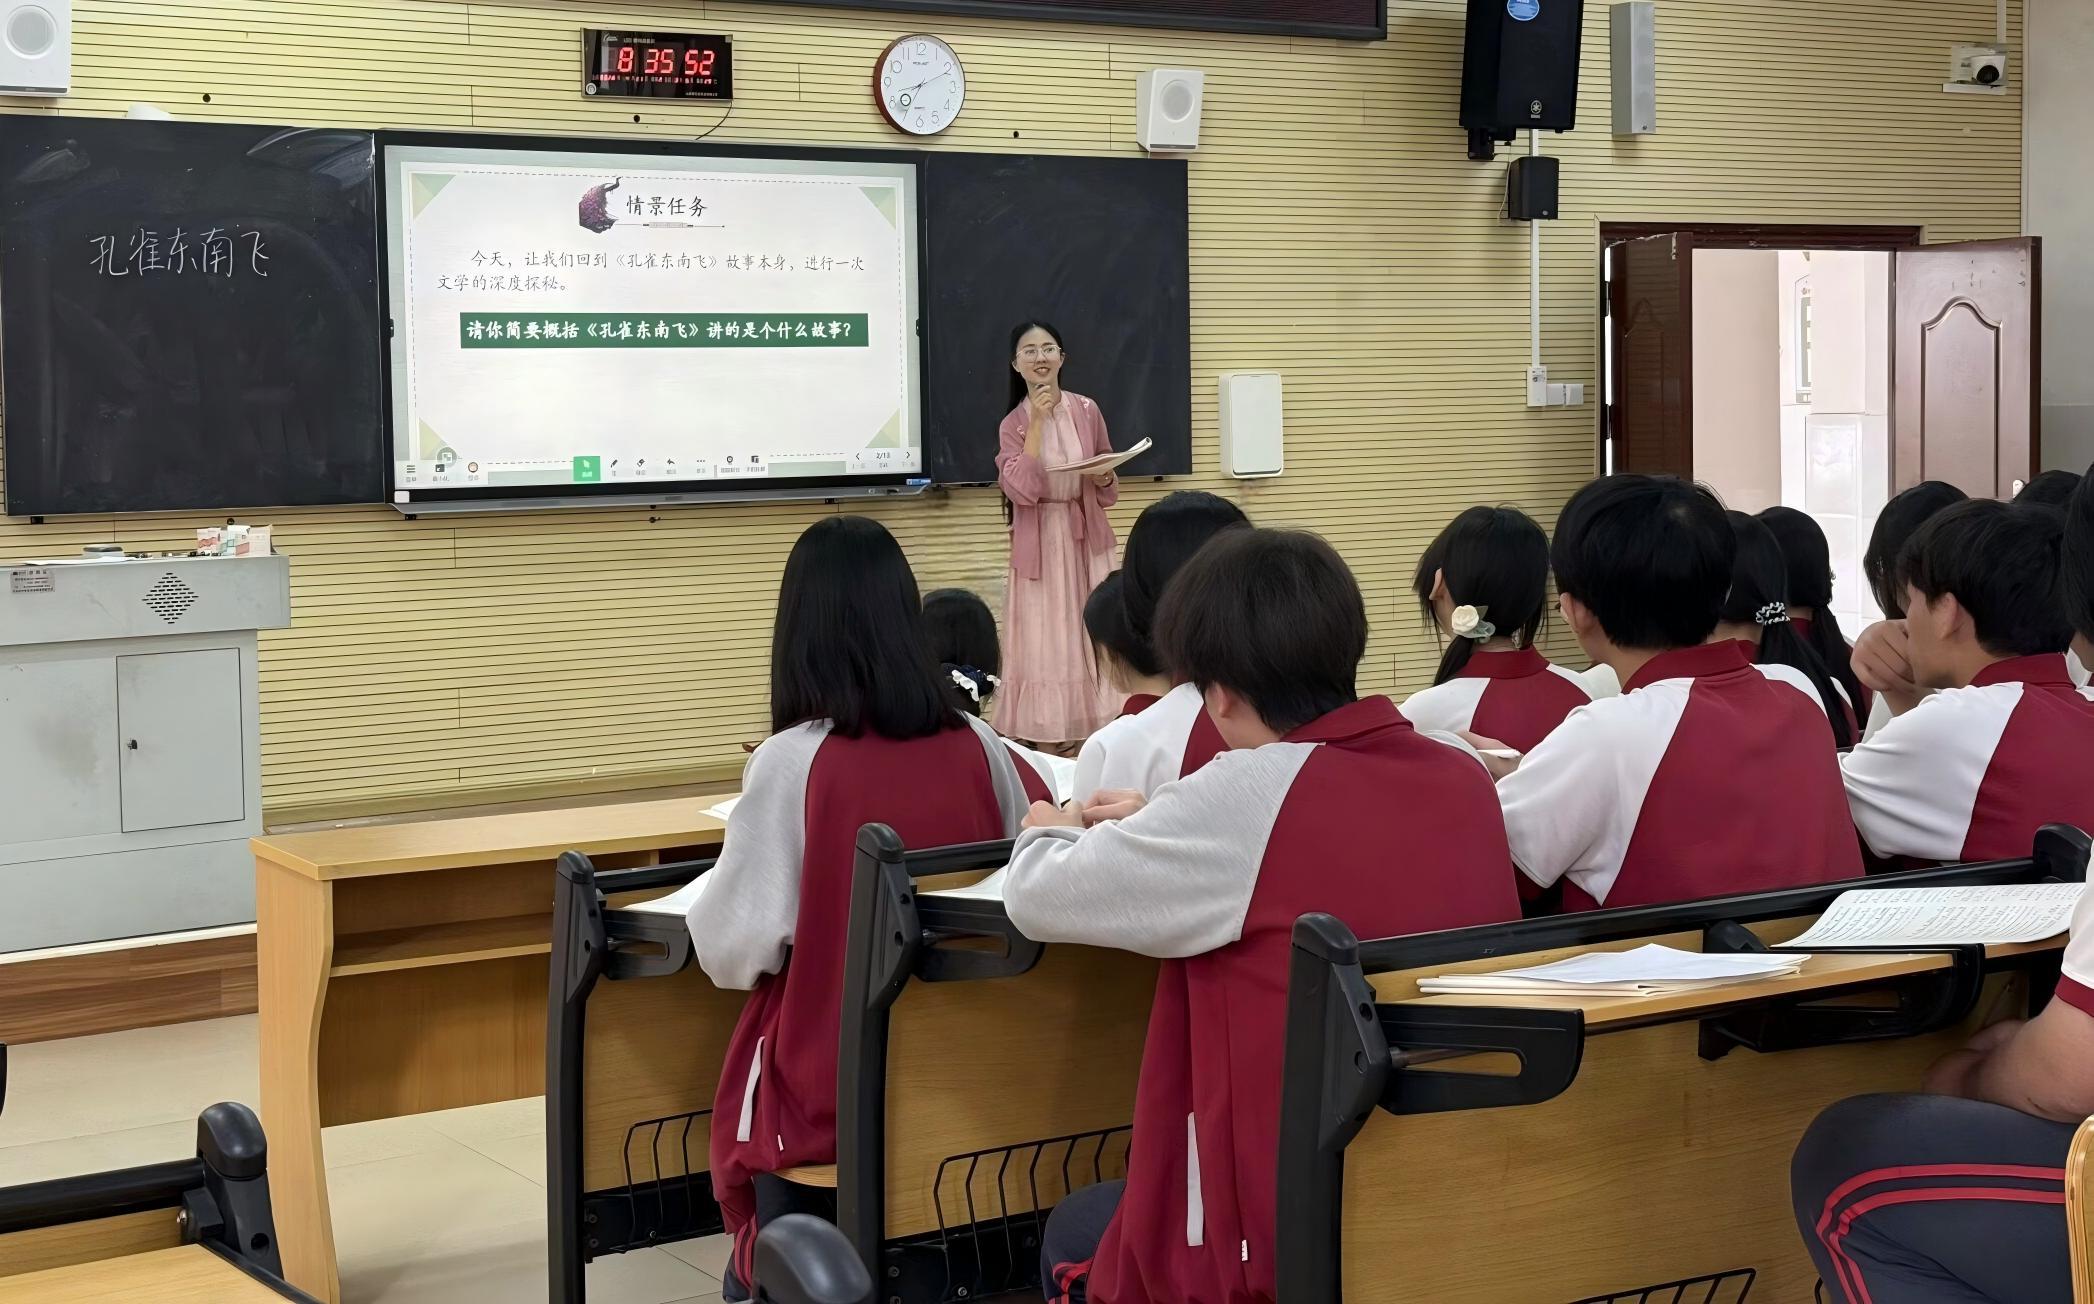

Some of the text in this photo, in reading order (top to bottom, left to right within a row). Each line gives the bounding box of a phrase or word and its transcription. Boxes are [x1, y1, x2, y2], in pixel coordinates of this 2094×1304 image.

[903, 48, 909, 60] 11
[916, 43, 927, 55] 12
[617, 47, 715, 76] 8 35 52
[890, 60, 902, 73] 10
[944, 62, 952, 75] 2
[884, 76, 891, 88] 9
[949, 81, 956, 93] 3
[889, 95, 896, 109] 8
[944, 98, 950, 111] 4
[916, 114, 924, 127] 6
[931, 111, 939, 124] 5
[625, 194, 708, 218] 情景任务
[89, 227, 270, 278] 孔雀东南飞
[471, 249, 865, 272] 今天，让我们回到《孔雀东南飞》故事本身，进行一次
[436, 274, 568, 292] 文学的深度探秘。
[466, 319, 851, 341] 请你简要概括《孔雀东南飞》讲的是个什么故事？
